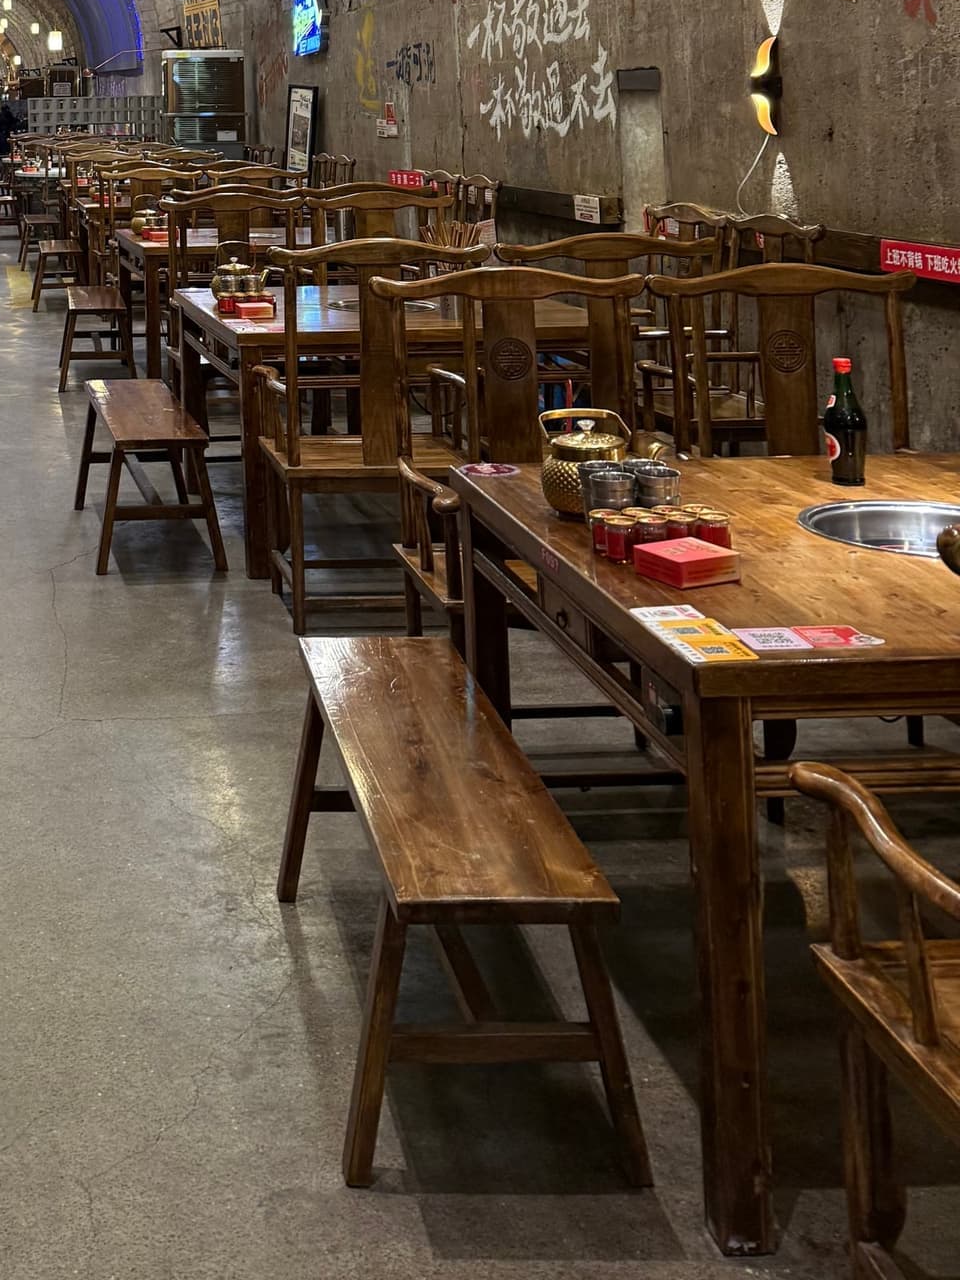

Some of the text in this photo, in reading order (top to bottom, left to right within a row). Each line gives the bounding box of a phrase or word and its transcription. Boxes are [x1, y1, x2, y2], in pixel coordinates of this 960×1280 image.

[885, 248, 923, 269] 上班不背锅
